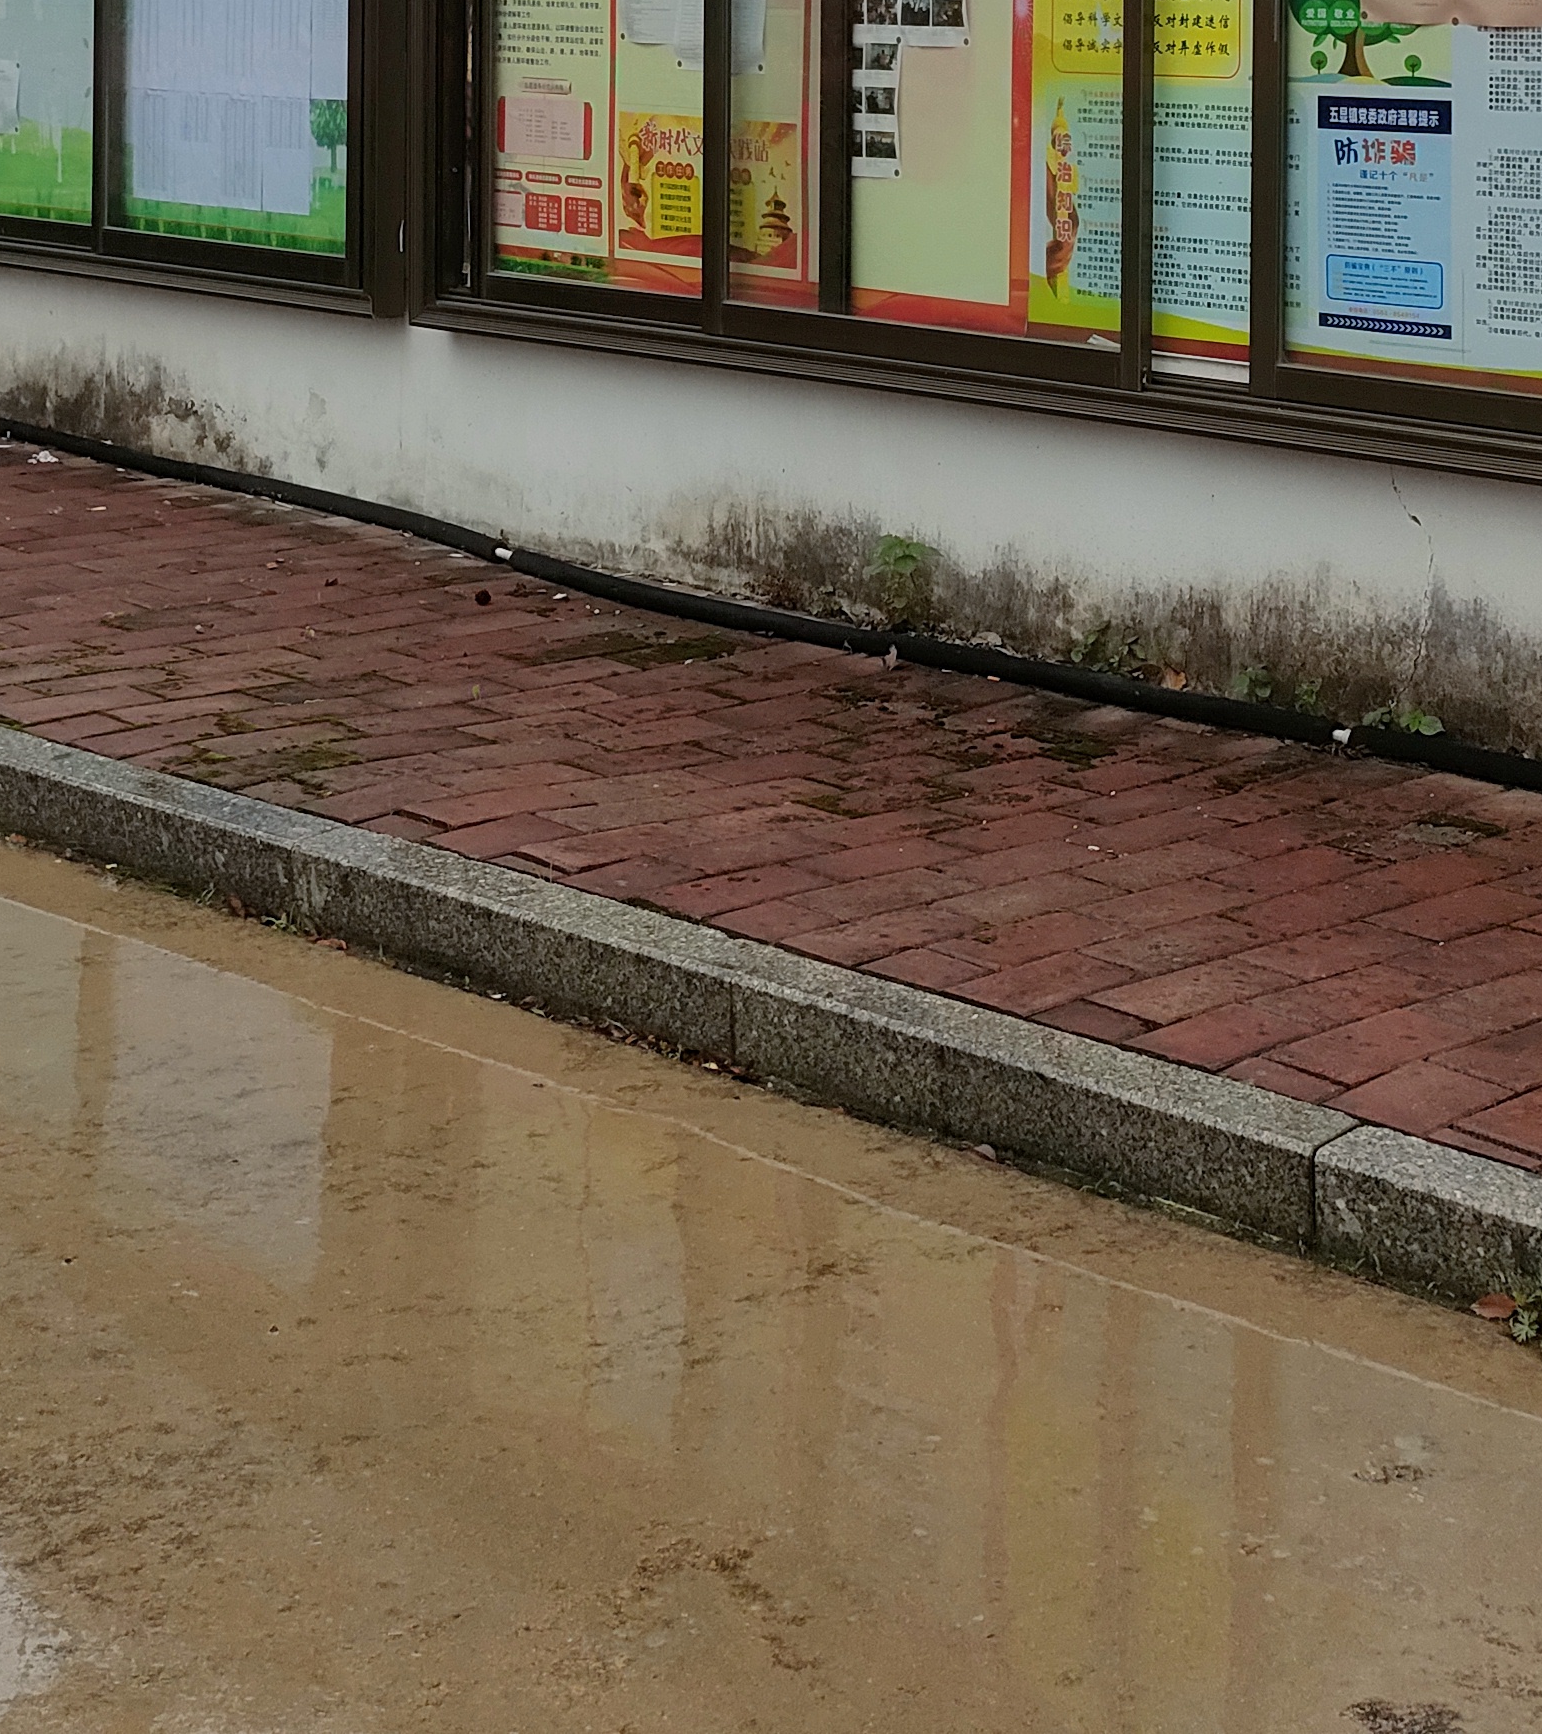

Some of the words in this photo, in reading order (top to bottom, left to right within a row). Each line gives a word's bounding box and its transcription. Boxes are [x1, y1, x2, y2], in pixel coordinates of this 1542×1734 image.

[1329, 106, 1440, 128] 五显镇党委政府温馨提示
[1334, 136, 1416, 166] 防诈骗
